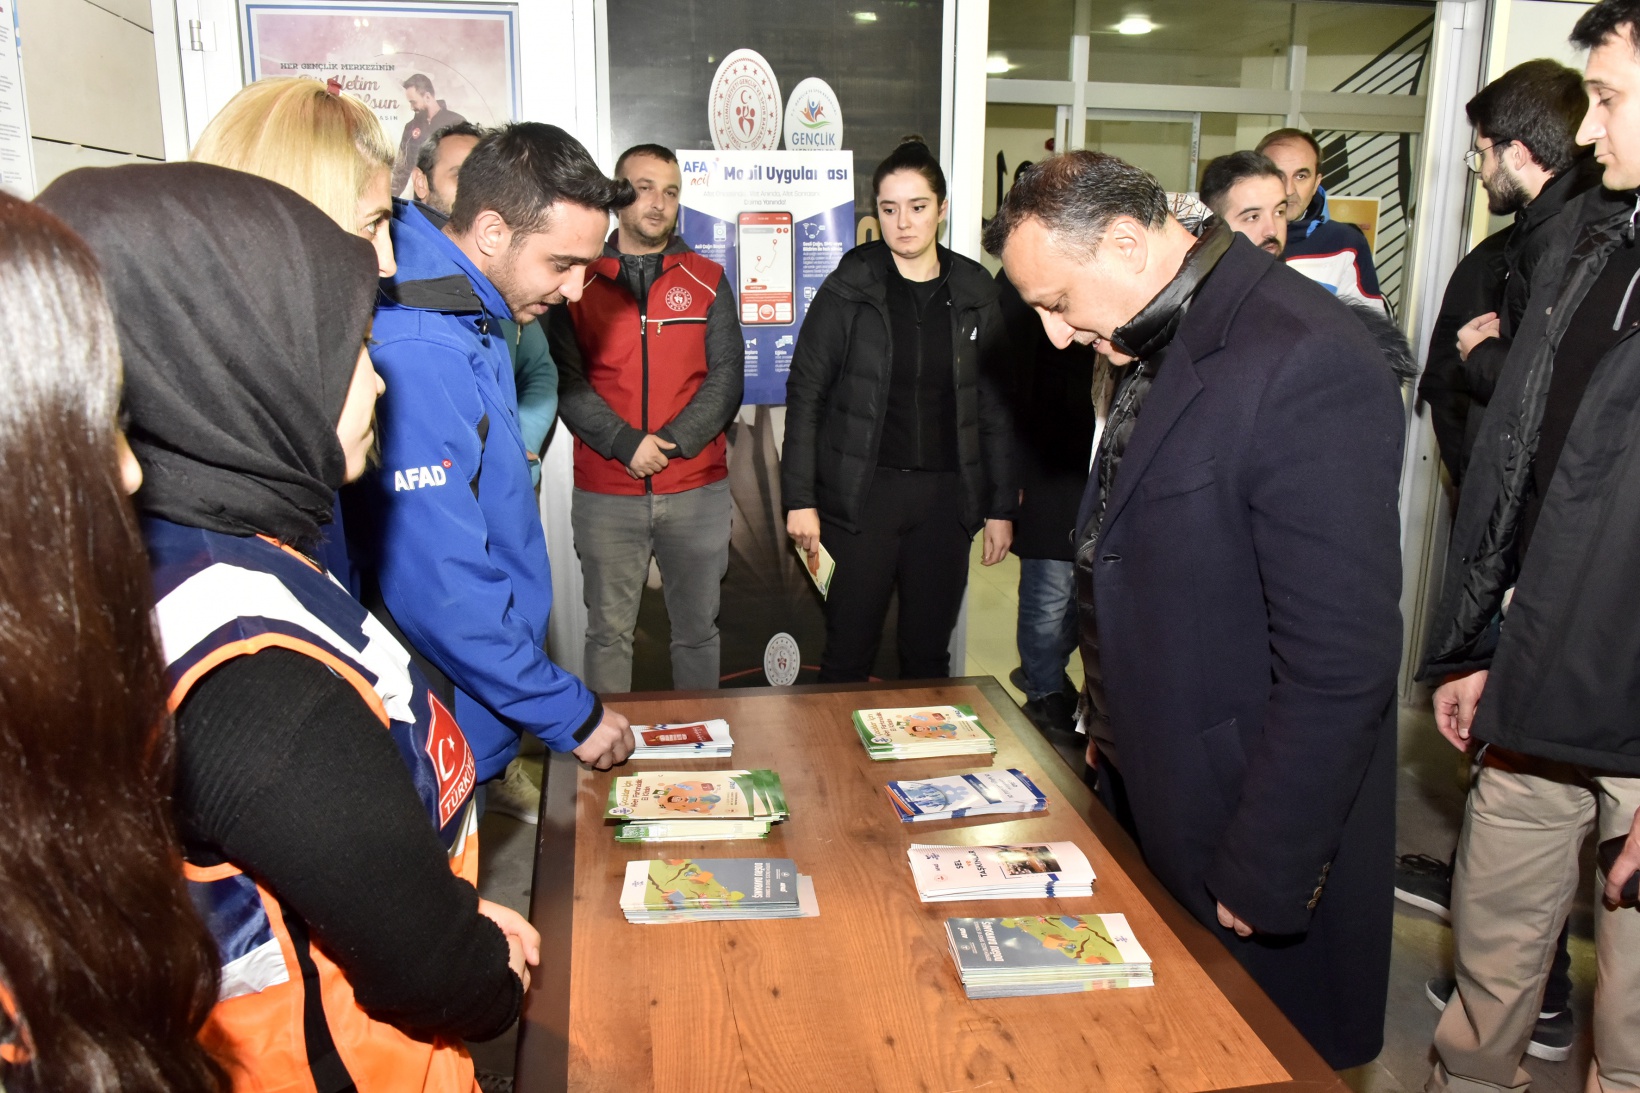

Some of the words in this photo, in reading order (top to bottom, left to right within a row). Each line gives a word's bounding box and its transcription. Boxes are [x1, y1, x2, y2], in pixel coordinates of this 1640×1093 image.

[301, 61, 339, 72] GENÇLİK
[341, 62, 395, 71] MERKEZİNİN
[791, 132, 836, 147] GENÇLİK
[690, 173, 711, 187] acil
[766, 166, 848, 184] Uygulaası
[395, 465, 447, 492] AFAD
[444, 752, 475, 815] TÜRKİYE
[954, 859, 964, 869] SEL
[968, 850, 987, 878] TAŞKINLAR
[990, 945, 1004, 961] DOĞRU
